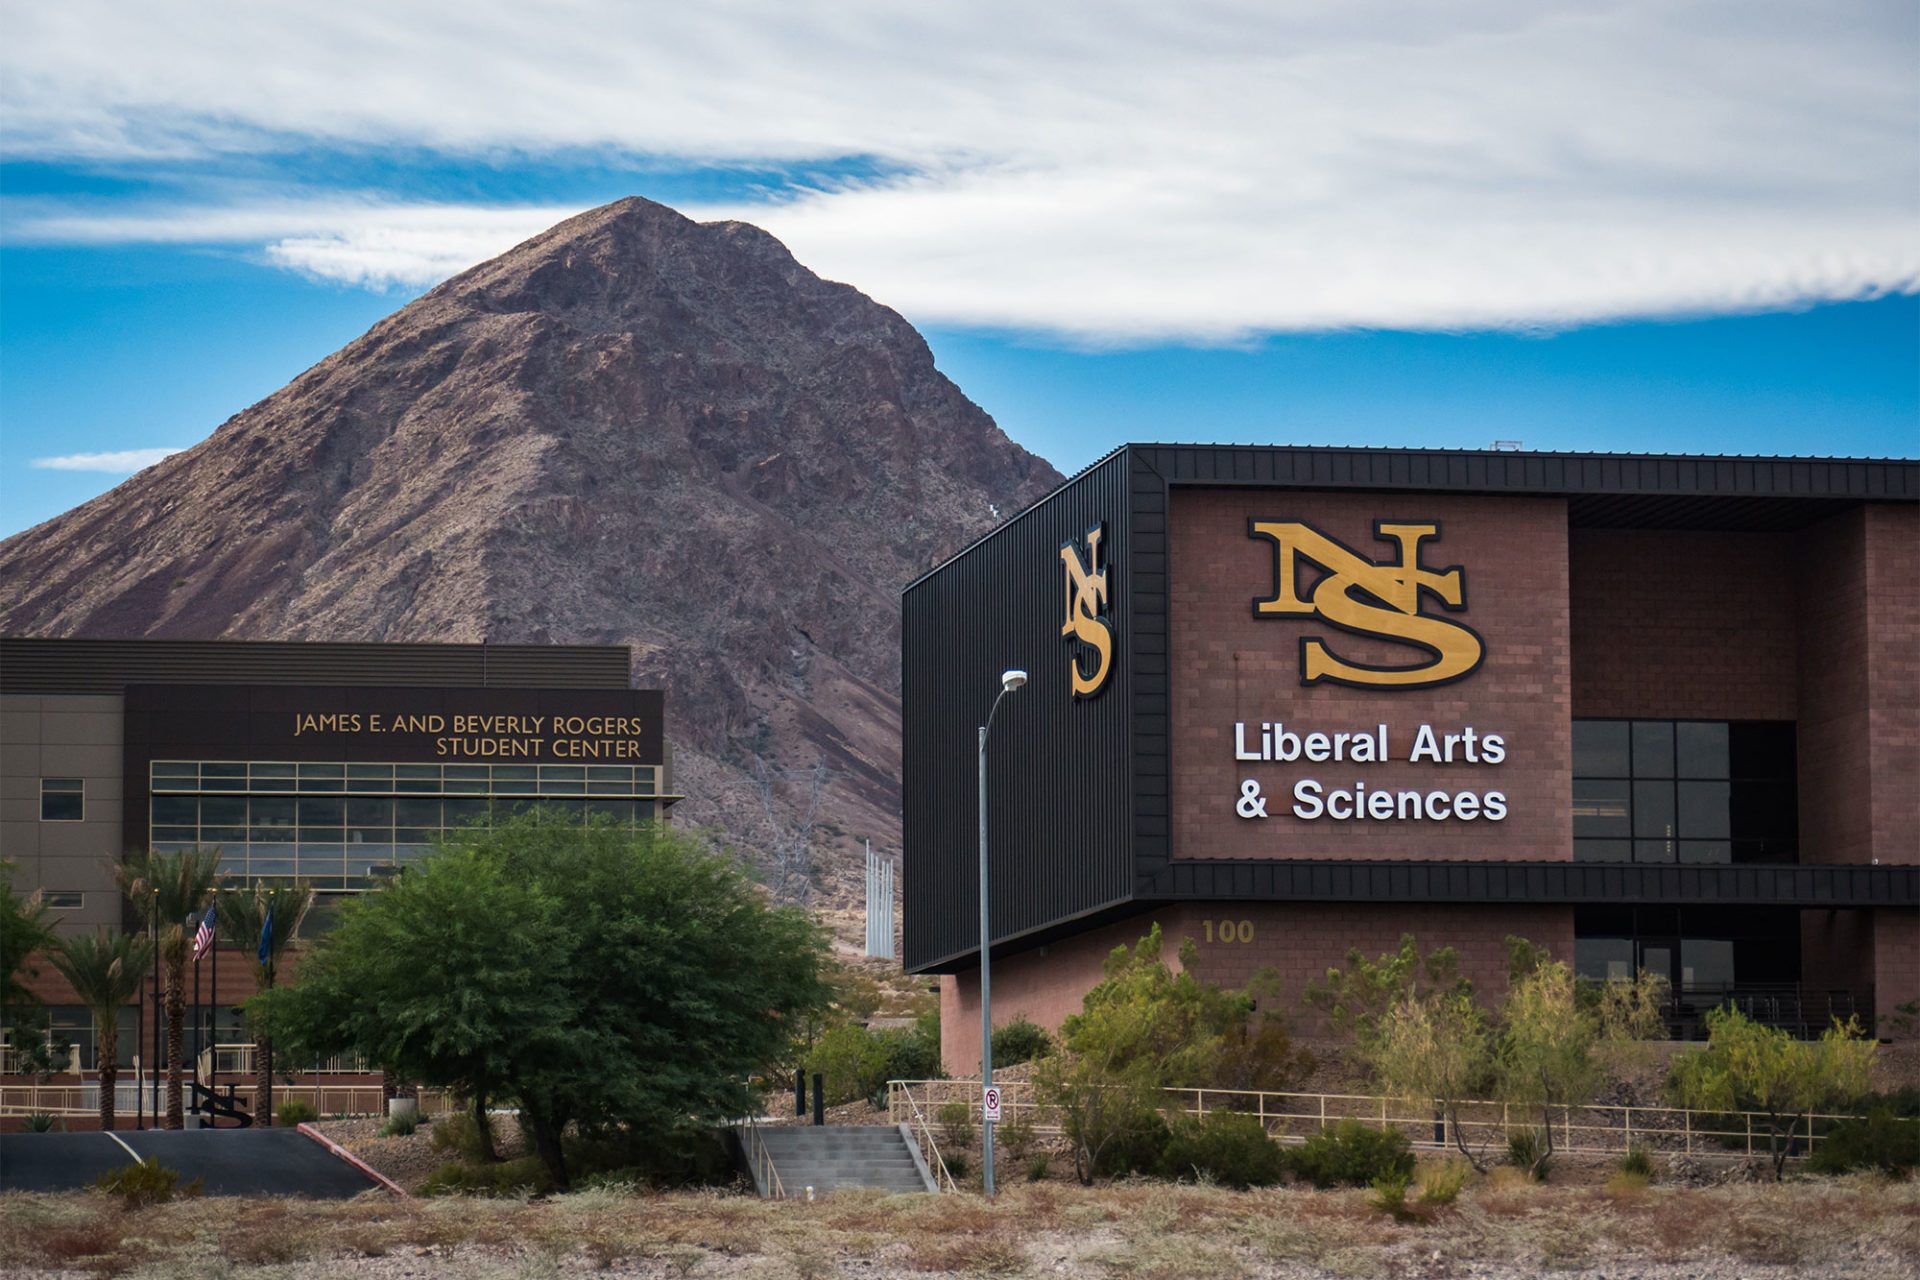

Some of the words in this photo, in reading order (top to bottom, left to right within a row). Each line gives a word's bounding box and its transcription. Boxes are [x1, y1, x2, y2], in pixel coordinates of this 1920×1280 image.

[294, 713, 361, 736] JAMES
[369, 714, 387, 733] E.
[391, 715, 446, 734] AND
[453, 715, 545, 735] BEVERLY
[553, 717, 642, 736] ROGERS
[436, 737, 545, 757] STUDENT
[551, 739, 642, 758] CENTER
[1235, 722, 1389, 763] Liberal
[1409, 724, 1507, 764] Arts
[1235, 779, 1269, 819] &
[1292, 779, 1508, 821] Sciences
[1202, 919, 1254, 943] 100
